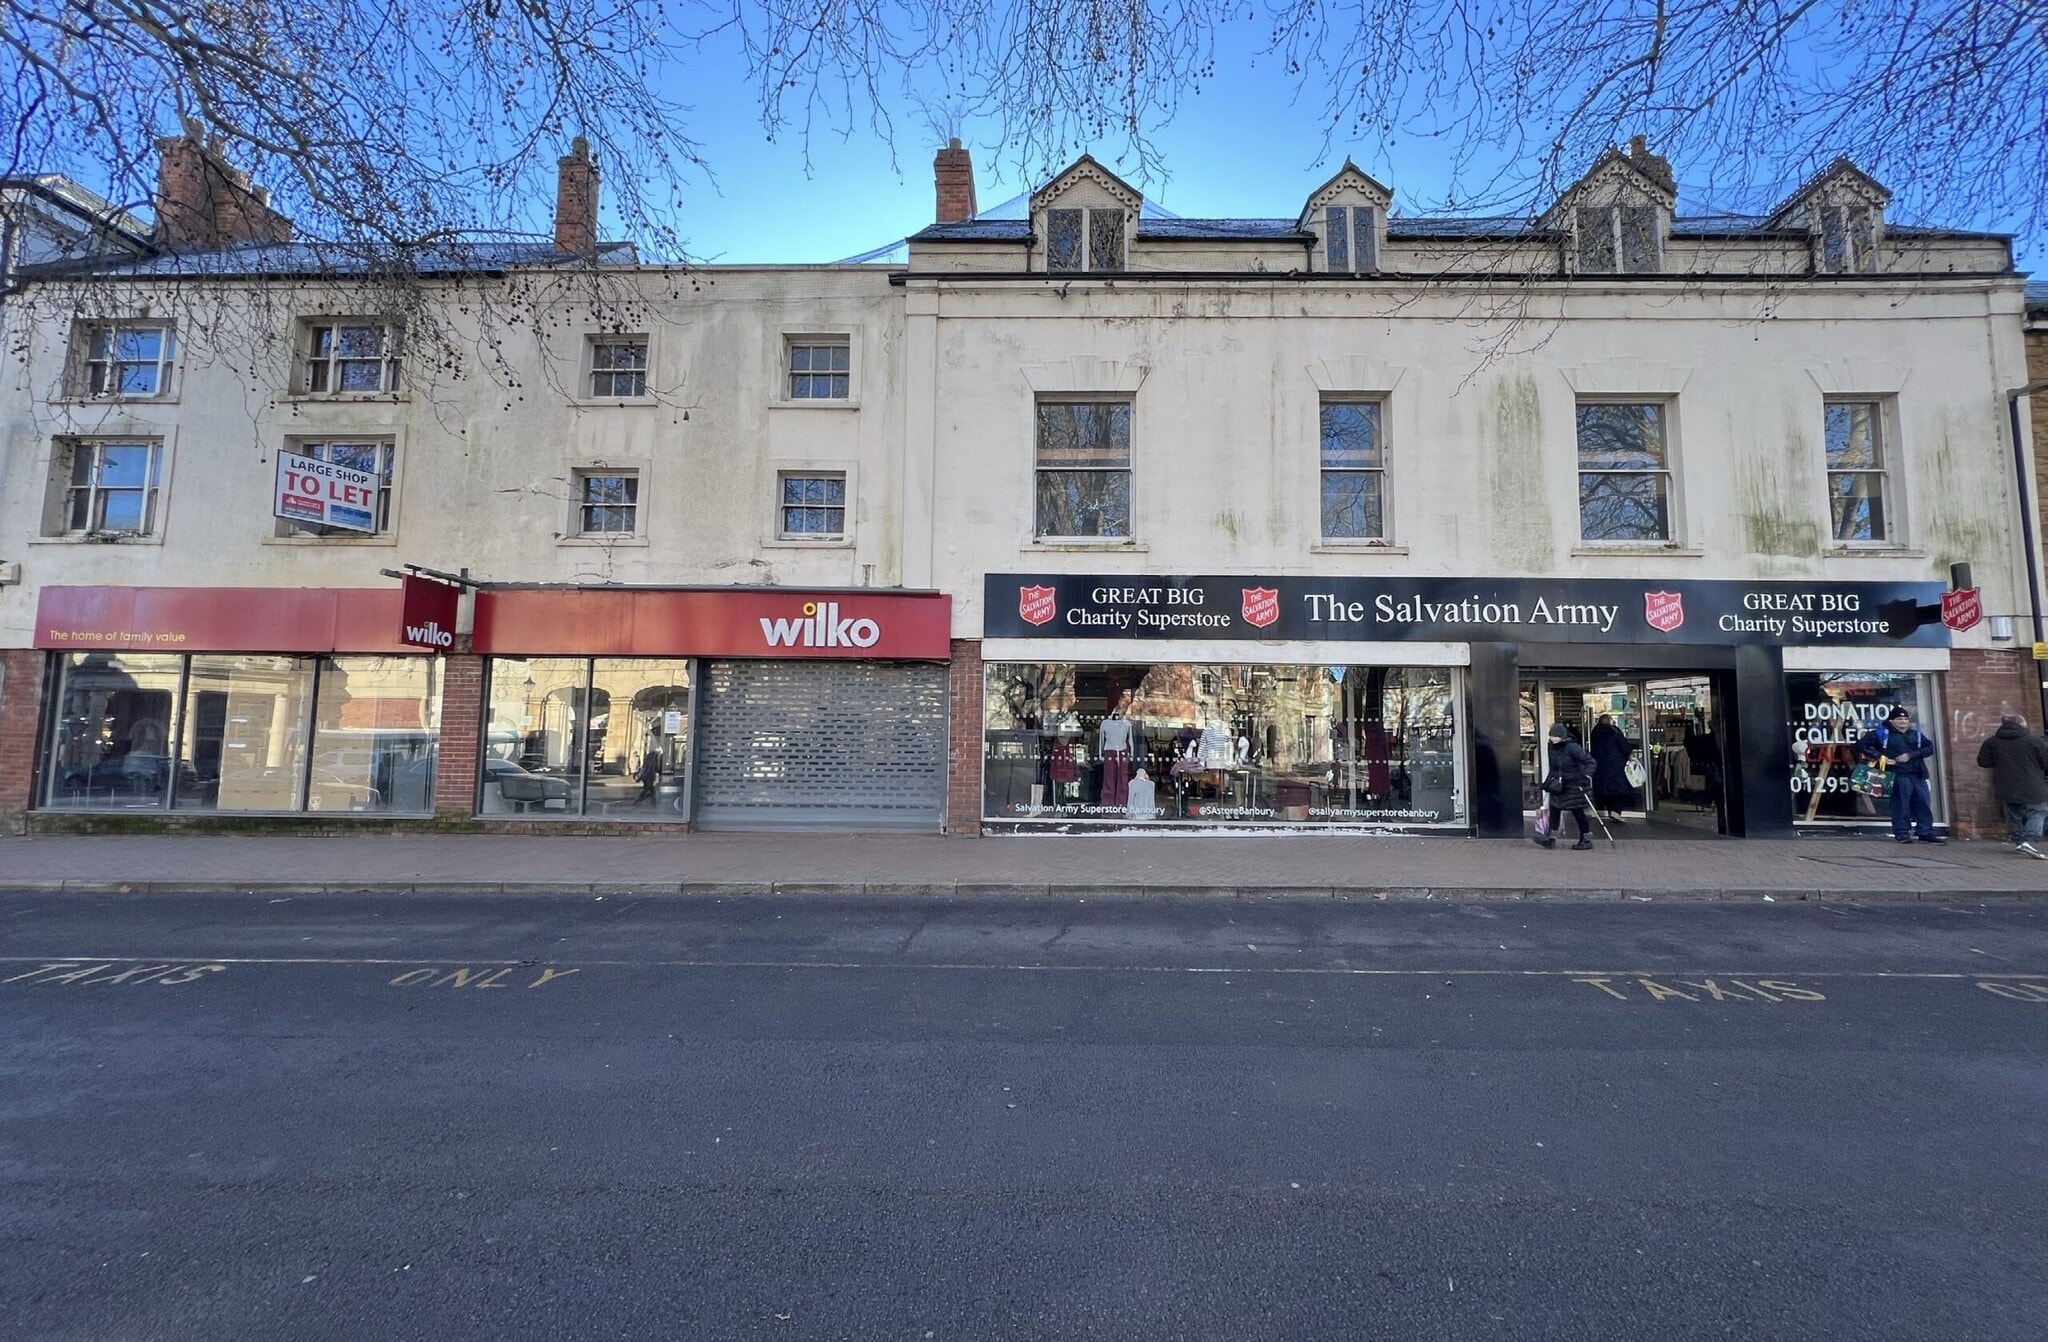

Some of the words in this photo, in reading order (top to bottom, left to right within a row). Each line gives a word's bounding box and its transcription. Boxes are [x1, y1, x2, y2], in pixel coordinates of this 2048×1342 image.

[291, 458, 333, 477] LARGE
[336, 469, 368, 484] SHOP
[285, 470, 320, 496] TO
[329, 481, 373, 507] LET
[1022, 593, 1053, 615] SALVATION
[1028, 590, 1040, 601] THE
[1092, 587, 1162, 605] GREAT
[1167, 588, 1205, 606] BIG
[1251, 592, 1263, 603] THE
[1653, 597, 1666, 607] THE
[1743, 593, 1815, 611] GREAT
[1821, 594, 1860, 611] BIG
[1949, 593, 1962, 607] THE
[1033, 604, 1051, 620] ARMY
[1244, 595, 1276, 617] SALVATION
[1256, 606, 1274, 622] ARMY
[1304, 593, 1364, 623] The
[1375, 593, 1520, 624] Salvation
[1528, 595, 1618, 633] Army
[1648, 600, 1679, 621] SALVATION
[1944, 594, 1978, 621] SALVATION
[760, 602, 880, 648] wilko
[1066, 608, 1132, 630] Charity
[1138, 609, 1231, 629] Superstore
[1661, 610, 1679, 627] ARMY
[1719, 614, 1786, 636] Charity
[1792, 616, 1890, 637] Superstore
[1956, 606, 1976, 626] ARMY
[50, 630, 68, 641] The
[71, 631, 103, 641] home
[105, 632, 117, 641] of
[120, 632, 153, 644] family
[155, 632, 186, 642] value
[406, 621, 452, 647] wilko
[1804, 703, 1901, 721] DONATIO
[1795, 727, 1876, 744] COLLEC
[1015, 803, 1054, 813] Salvation
[1056, 804, 1078, 815] Army
[1081, 804, 1127, 815] Superstore
[1129, 805, 1165, 815] Banbury
[1199, 806, 1275, 817] @SAstoreBanbury
[1308, 806, 1440, 819] @sallyarmysuperstorebanbury
[1, 963, 227, 985] TAXIS
[389, 968, 581, 989] ONLY
[1572, 979, 1827, 1001] TAXIS
